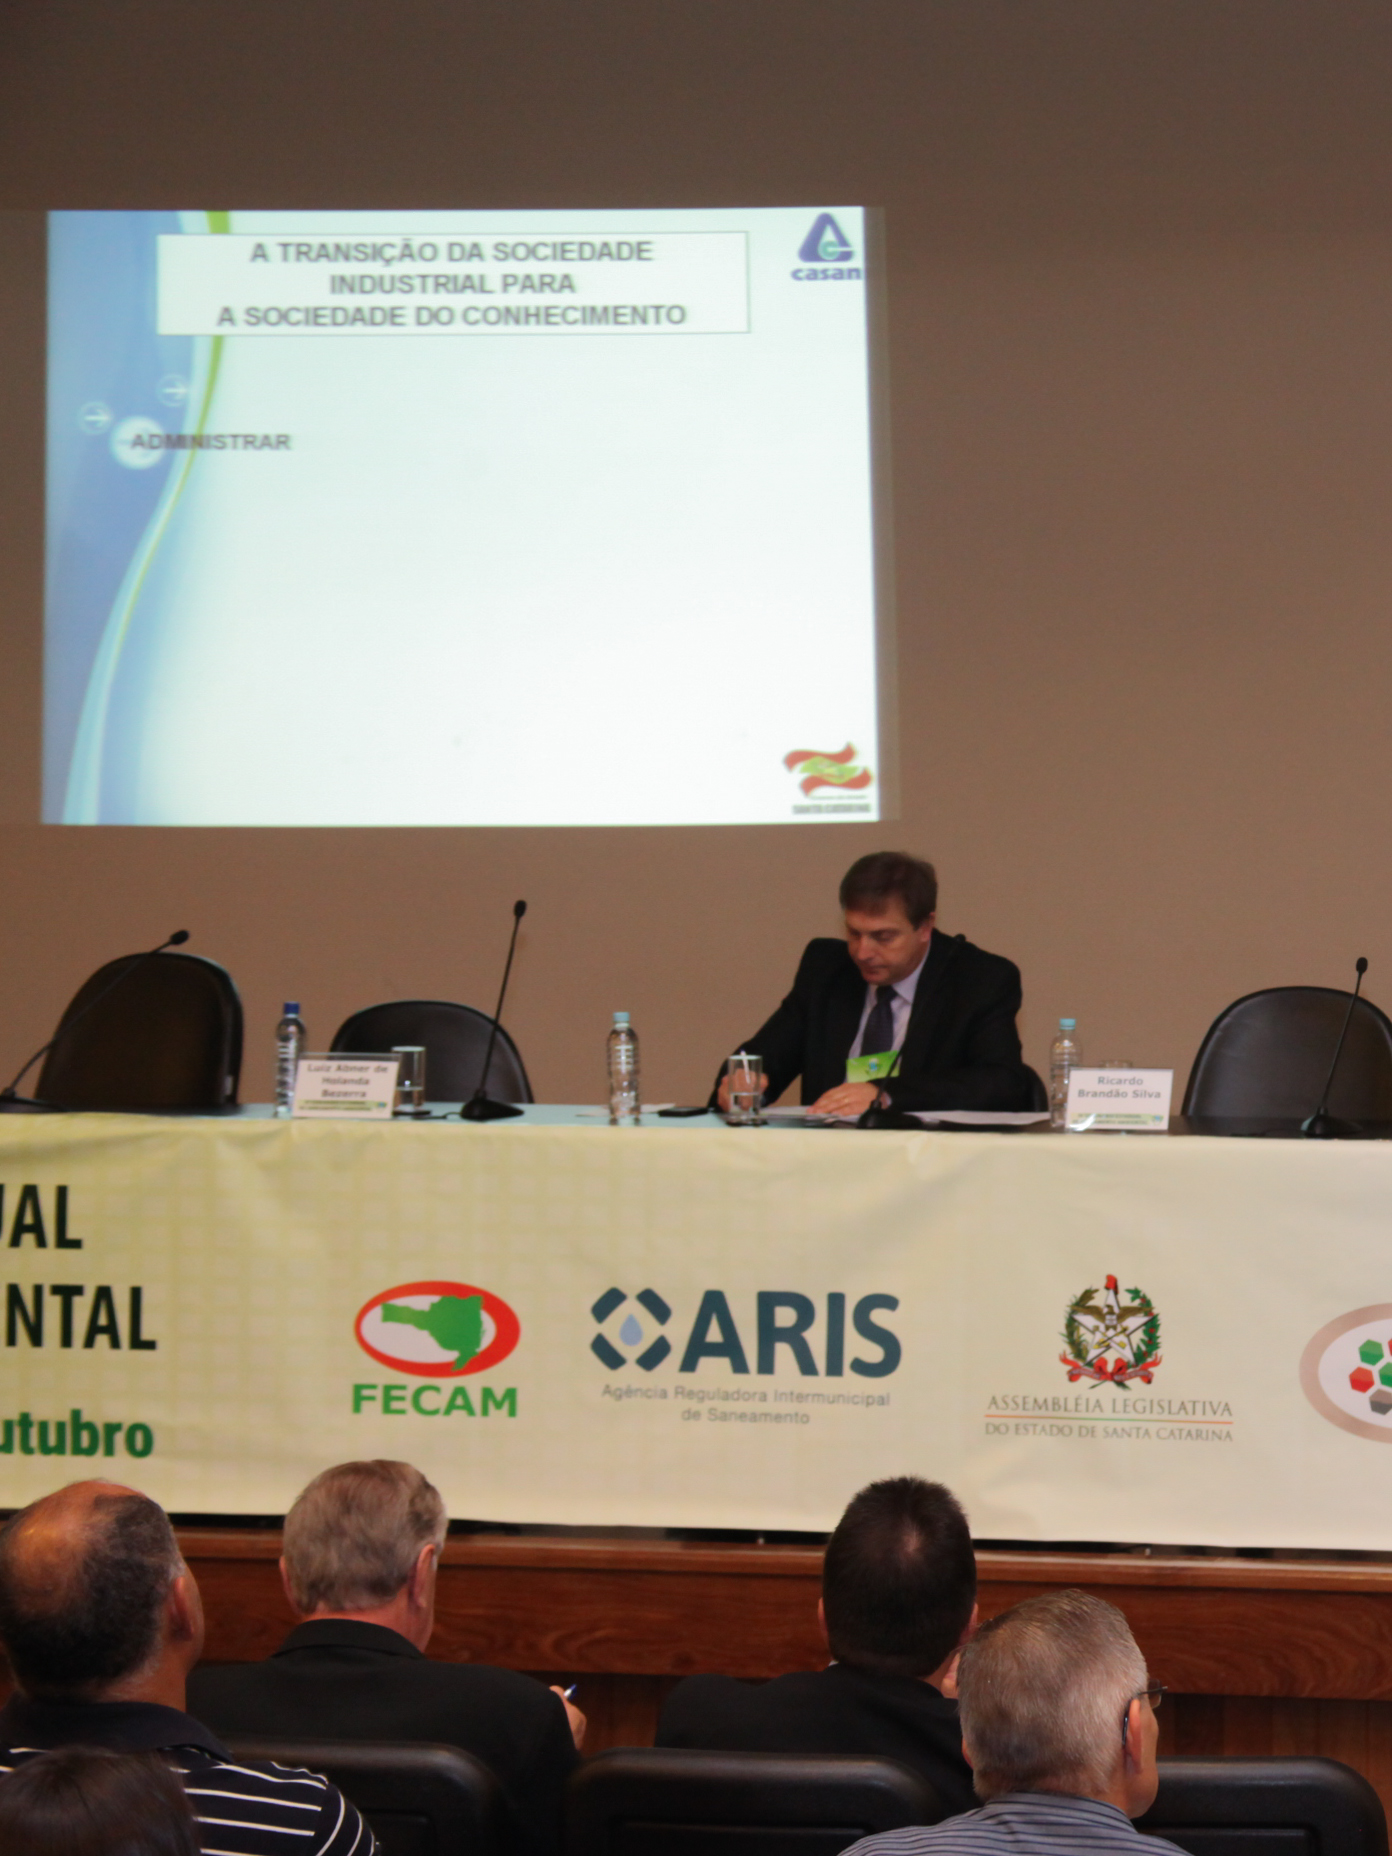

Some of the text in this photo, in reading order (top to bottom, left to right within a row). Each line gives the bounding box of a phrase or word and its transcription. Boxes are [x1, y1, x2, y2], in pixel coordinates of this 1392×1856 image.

[250, 238, 654, 267] A TRANSIÇÃO DA SOCIEDADE
[330, 273, 576, 295] INDUSTRIAL PARA
[791, 267, 862, 281] casan
[216, 304, 686, 326] A SOCIEDADE DO CONHECIMENTO
[132, 434, 291, 450] ADMINISTRAR
[374, 1065, 388, 1073] de
[1097, 1076, 1143, 1086] Ricardo
[1078, 1089, 1161, 1099] Brandão Silva
[0, 1183, 82, 1249] AL
[678, 1290, 902, 1378] ARIS
[352, 1384, 517, 1417] FECAM
[602, 1383, 890, 1407] Agência Reguladora Intermunicipal
[987, 1395, 1233, 1417] ASSEMBLÉIA LEGISLATIVA
[681, 1408, 810, 1424] de Saneamento
[985, 1423, 1233, 1442] DO ESTADO DE SANTA CATARINA
